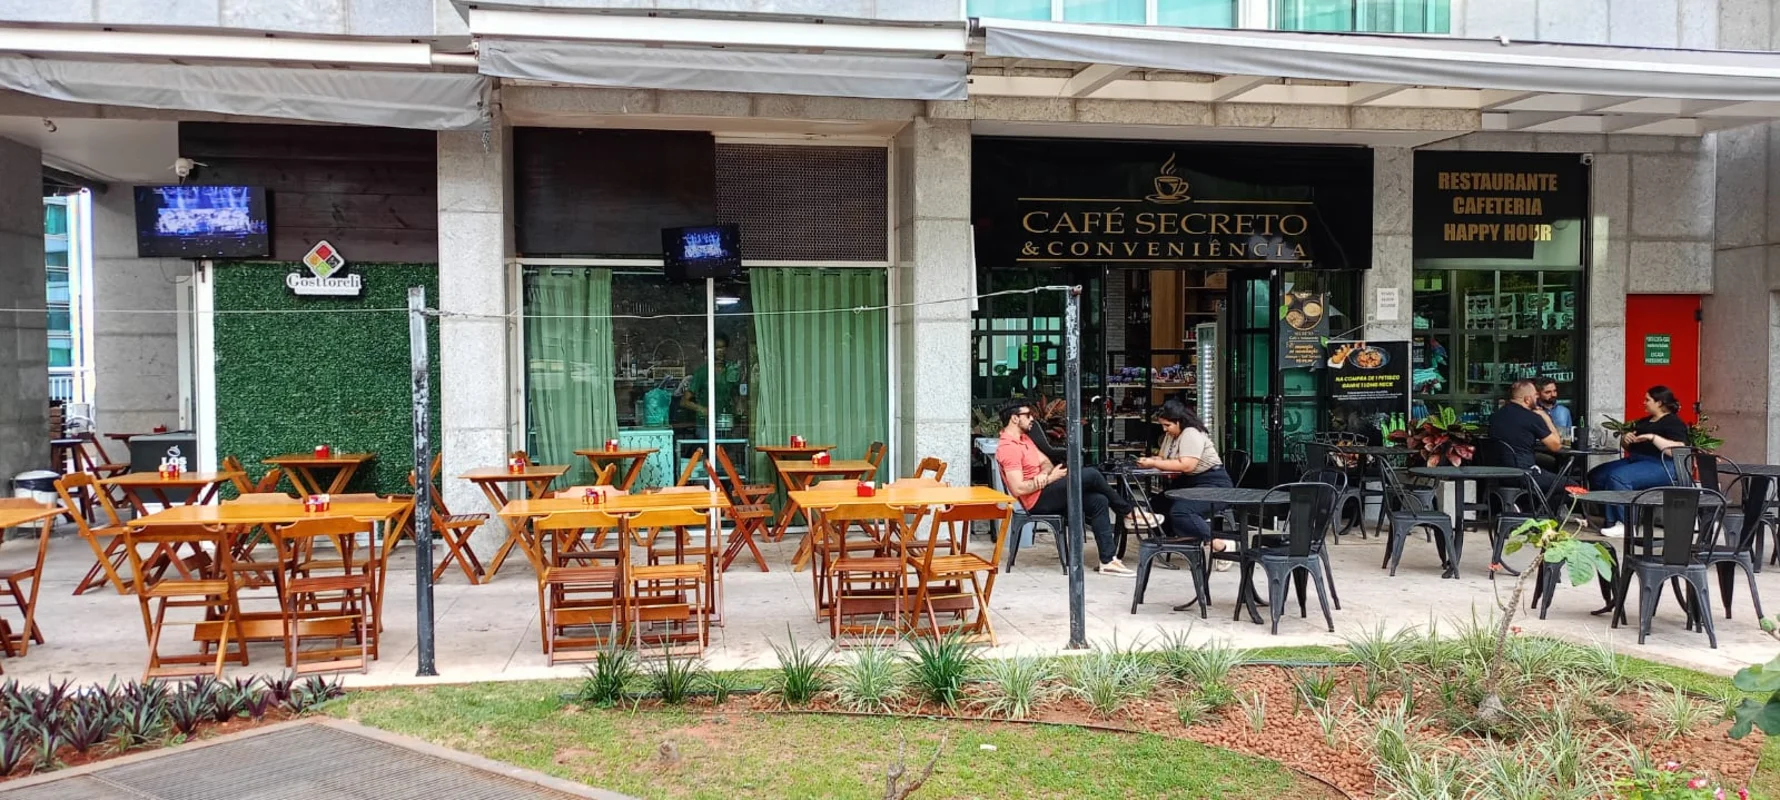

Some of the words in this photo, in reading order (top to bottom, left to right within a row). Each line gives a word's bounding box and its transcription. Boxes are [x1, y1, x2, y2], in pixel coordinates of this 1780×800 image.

[1438, 172, 1558, 191] RESTAURANTE
[1453, 197, 1543, 215] CAFETERIA
[1022, 206, 1125, 234] CAFÉ
[1135, 212, 1308, 236] SECRETO
[1443, 223, 1500, 241] HAPPY
[1503, 224, 1552, 241] HOUR
[1021, 241, 1040, 256] &
[1047, 238, 1306, 257] CONVENIÊNCIA
